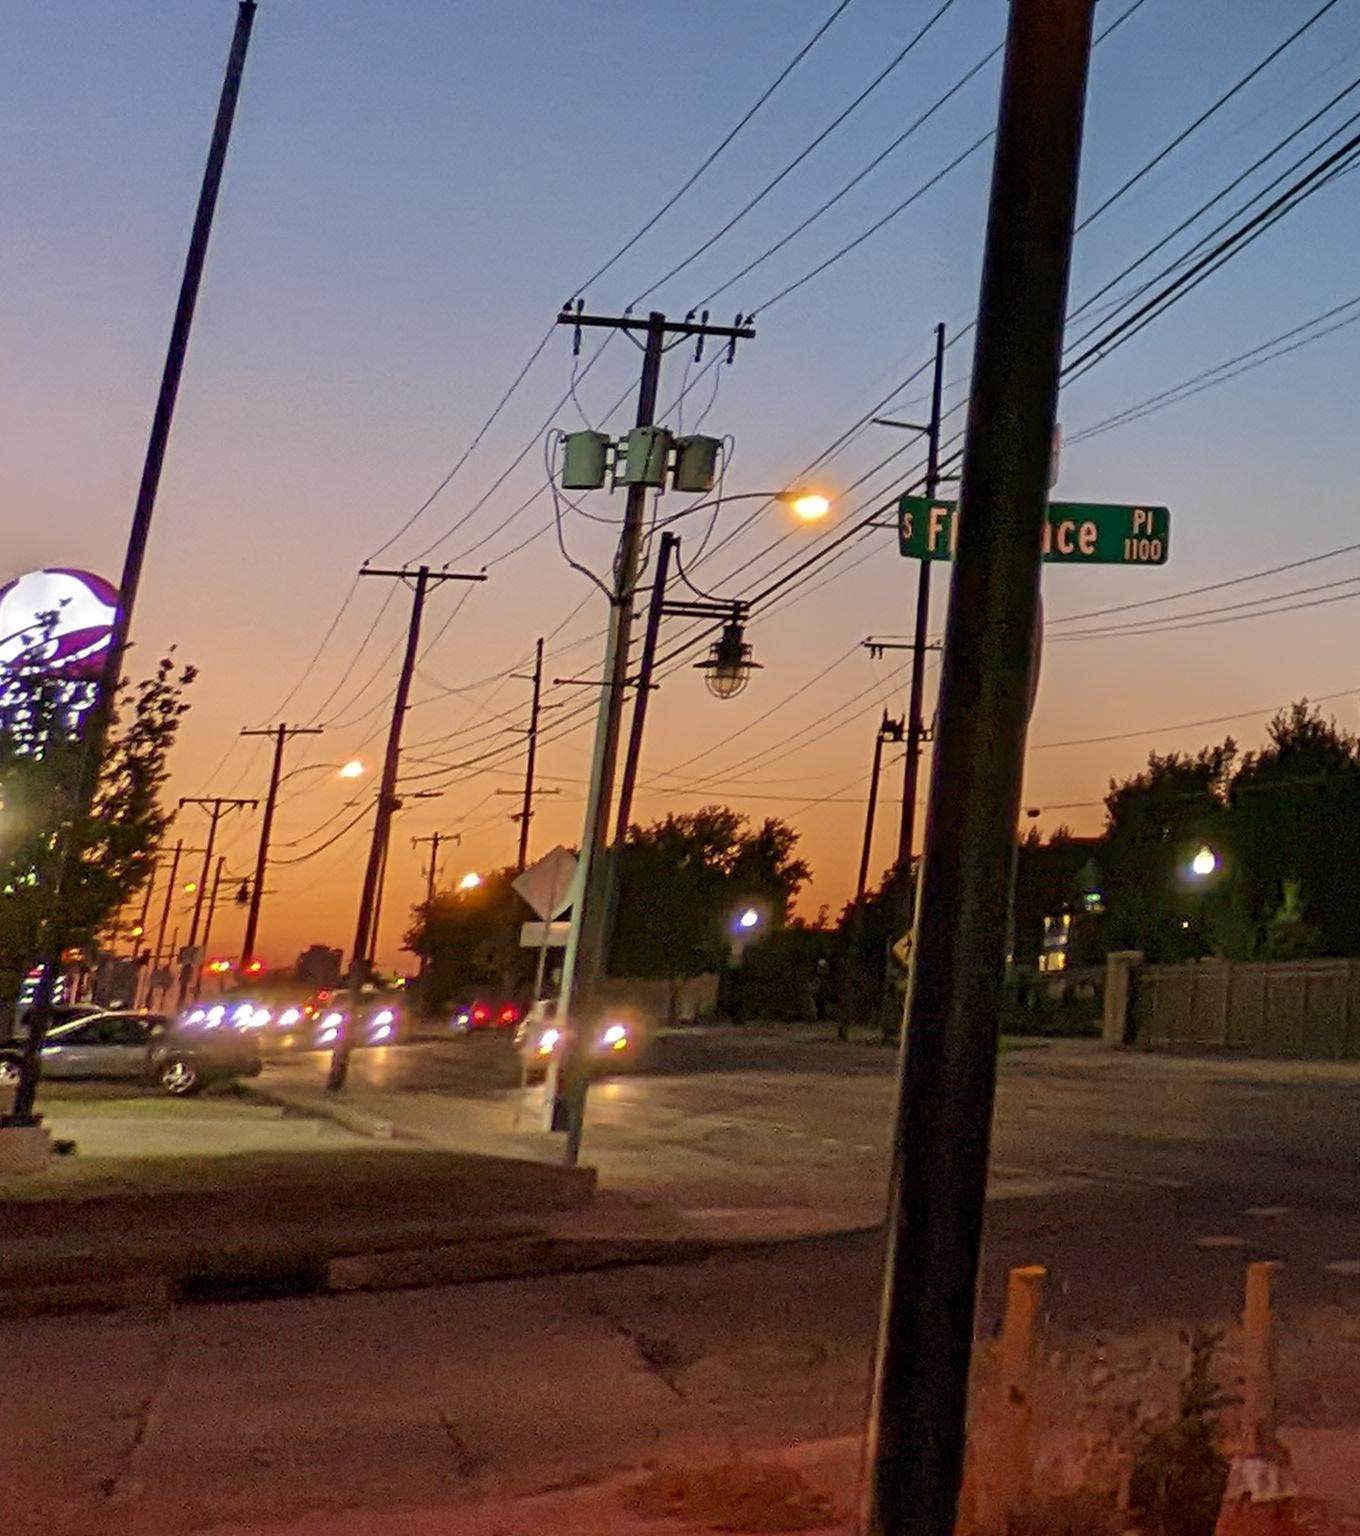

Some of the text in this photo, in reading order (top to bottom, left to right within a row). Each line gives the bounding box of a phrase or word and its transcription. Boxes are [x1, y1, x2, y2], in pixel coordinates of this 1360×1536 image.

[903, 512, 914, 540] S
[1133, 509, 1153, 535] Pl
[1123, 538, 1161, 561] 1100
